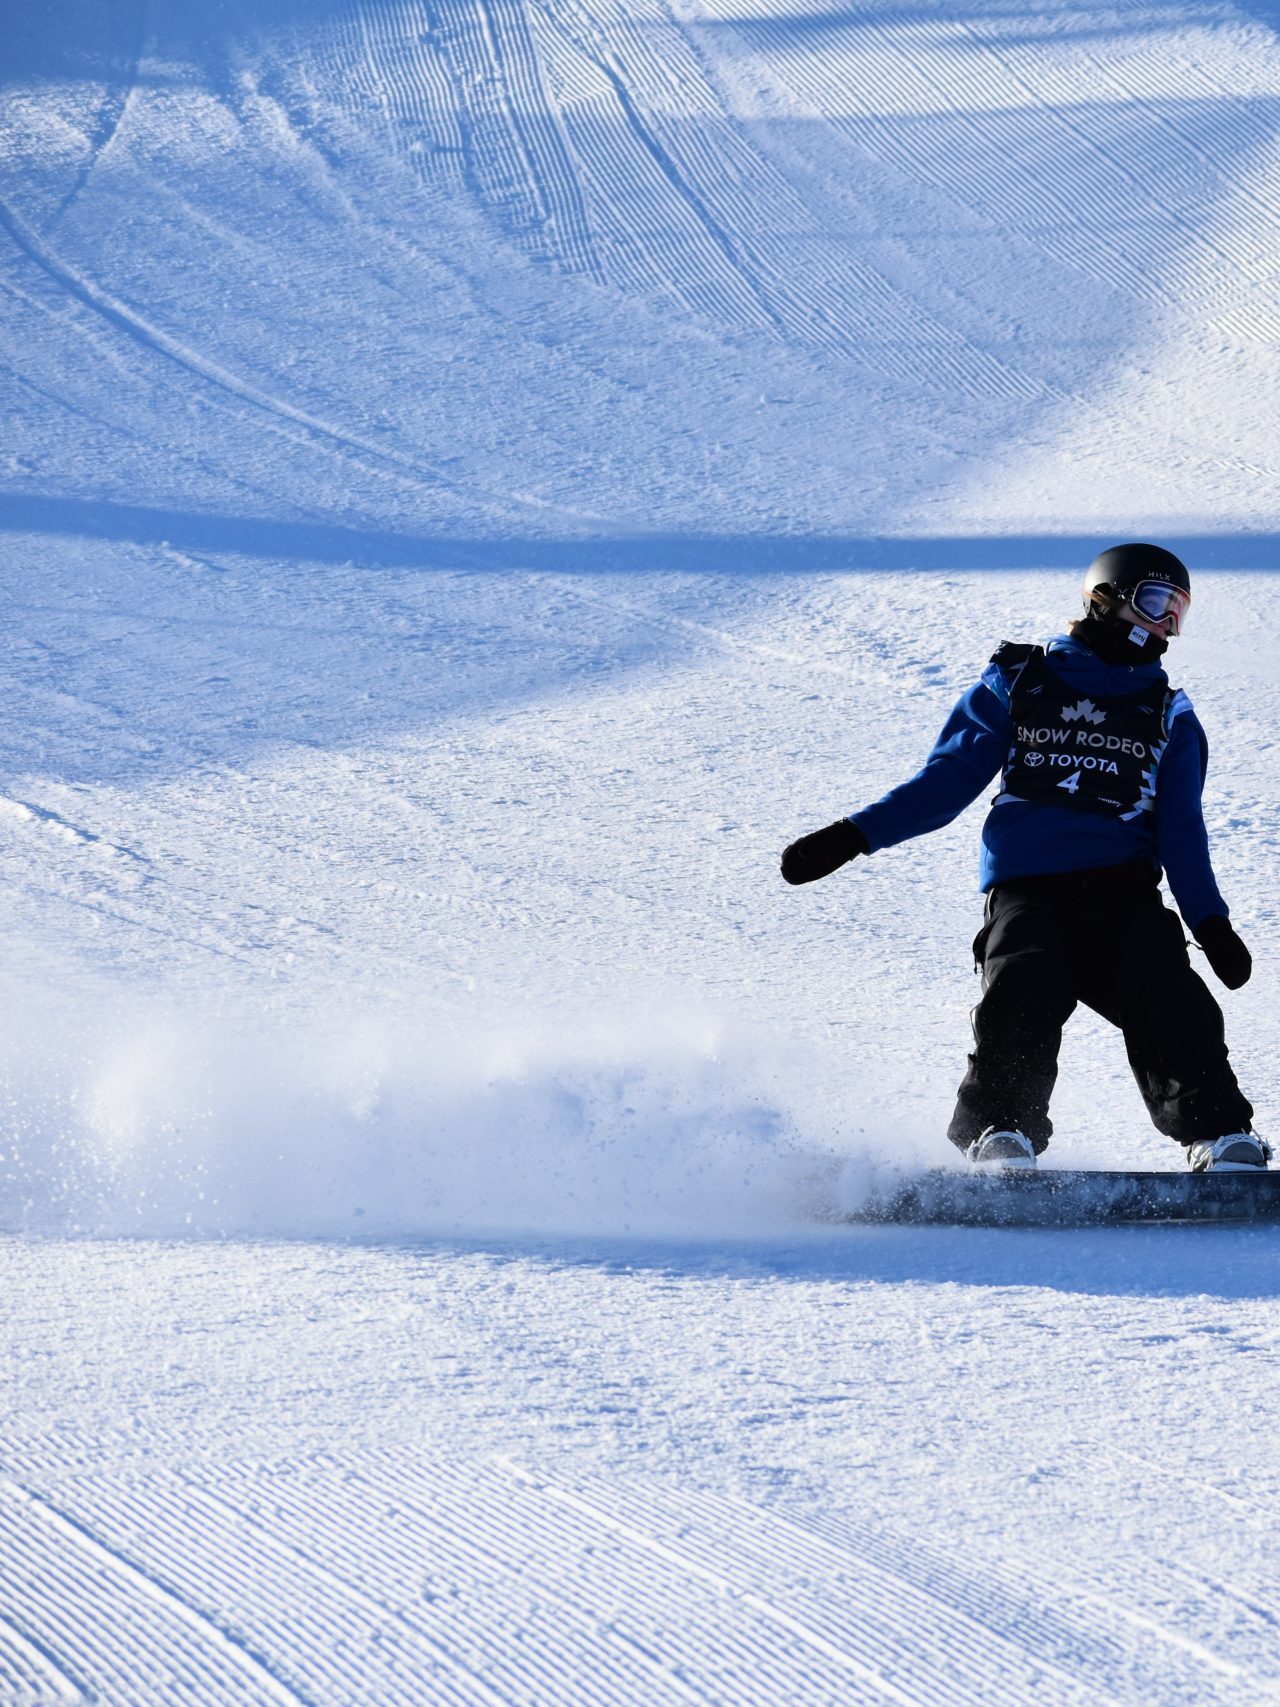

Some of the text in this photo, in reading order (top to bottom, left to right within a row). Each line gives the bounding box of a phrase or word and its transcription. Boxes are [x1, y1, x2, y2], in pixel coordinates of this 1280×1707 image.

[1017, 726, 1146, 758] SNOW RODEO
[1048, 753, 1119, 775] TOYOTA
[1056, 769, 1081, 794] 4
